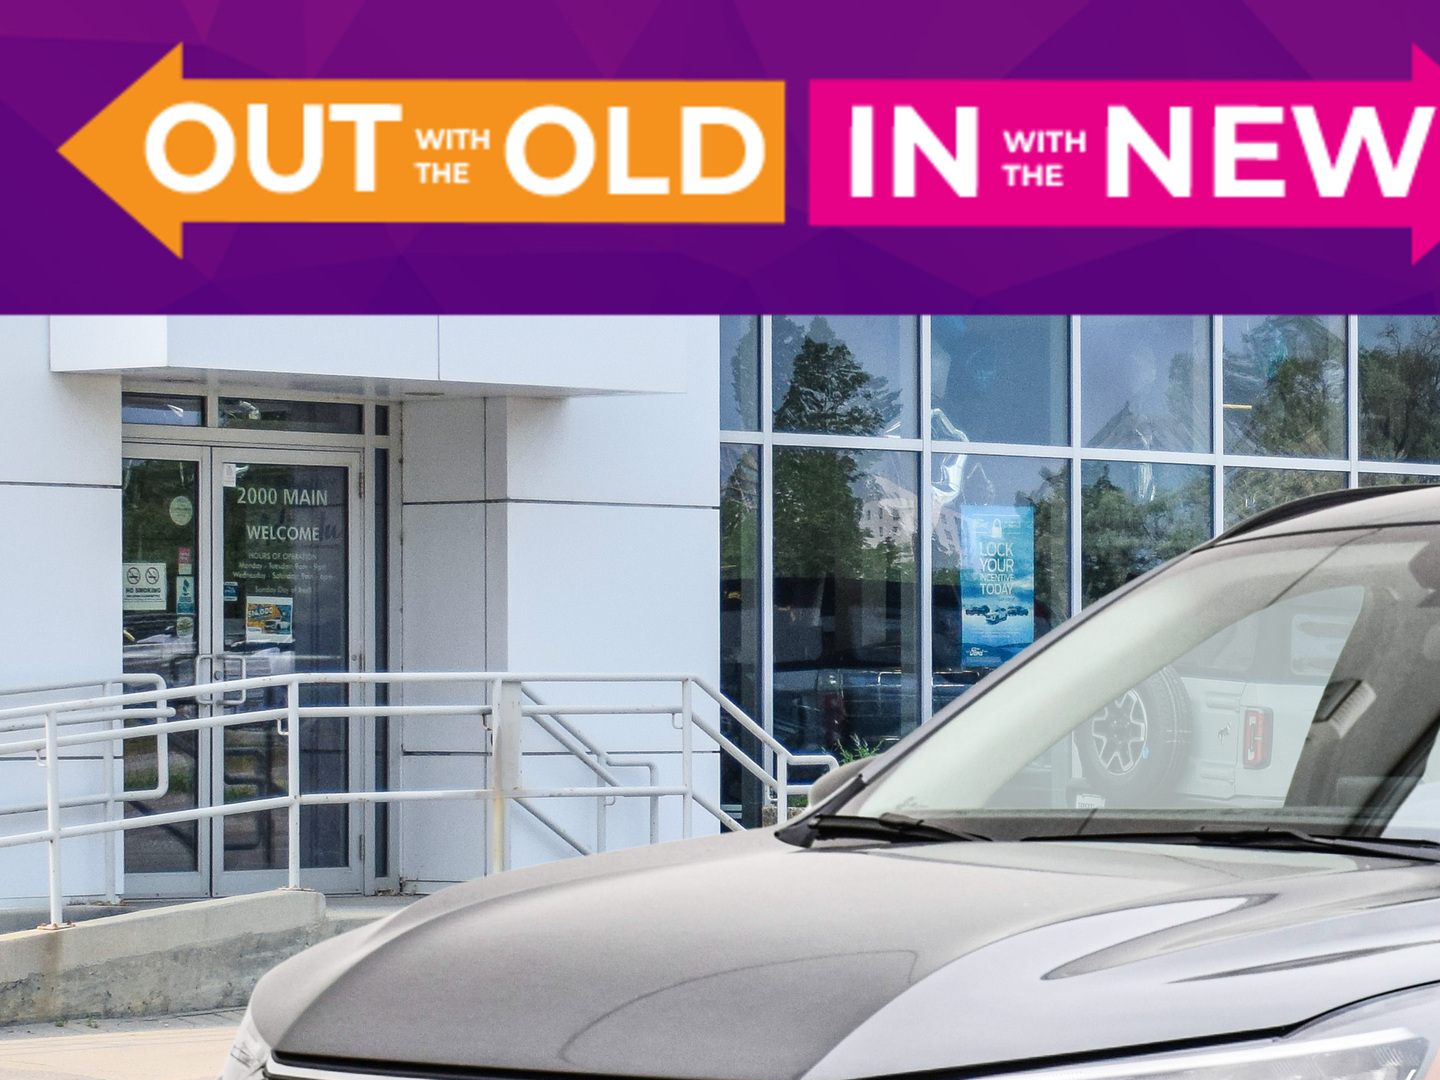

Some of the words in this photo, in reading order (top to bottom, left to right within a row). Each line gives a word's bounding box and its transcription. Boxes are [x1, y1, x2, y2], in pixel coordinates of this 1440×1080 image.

[237, 487, 278, 505] 2000
[283, 488, 328, 506] MAIN
[246, 525, 320, 541] WELCOME
[979, 541, 1014, 557] LOCK
[980, 558, 1014, 572] YOUR
[980, 573, 1015, 582] INCENTIVE
[979, 583, 1014, 596] TODAY
